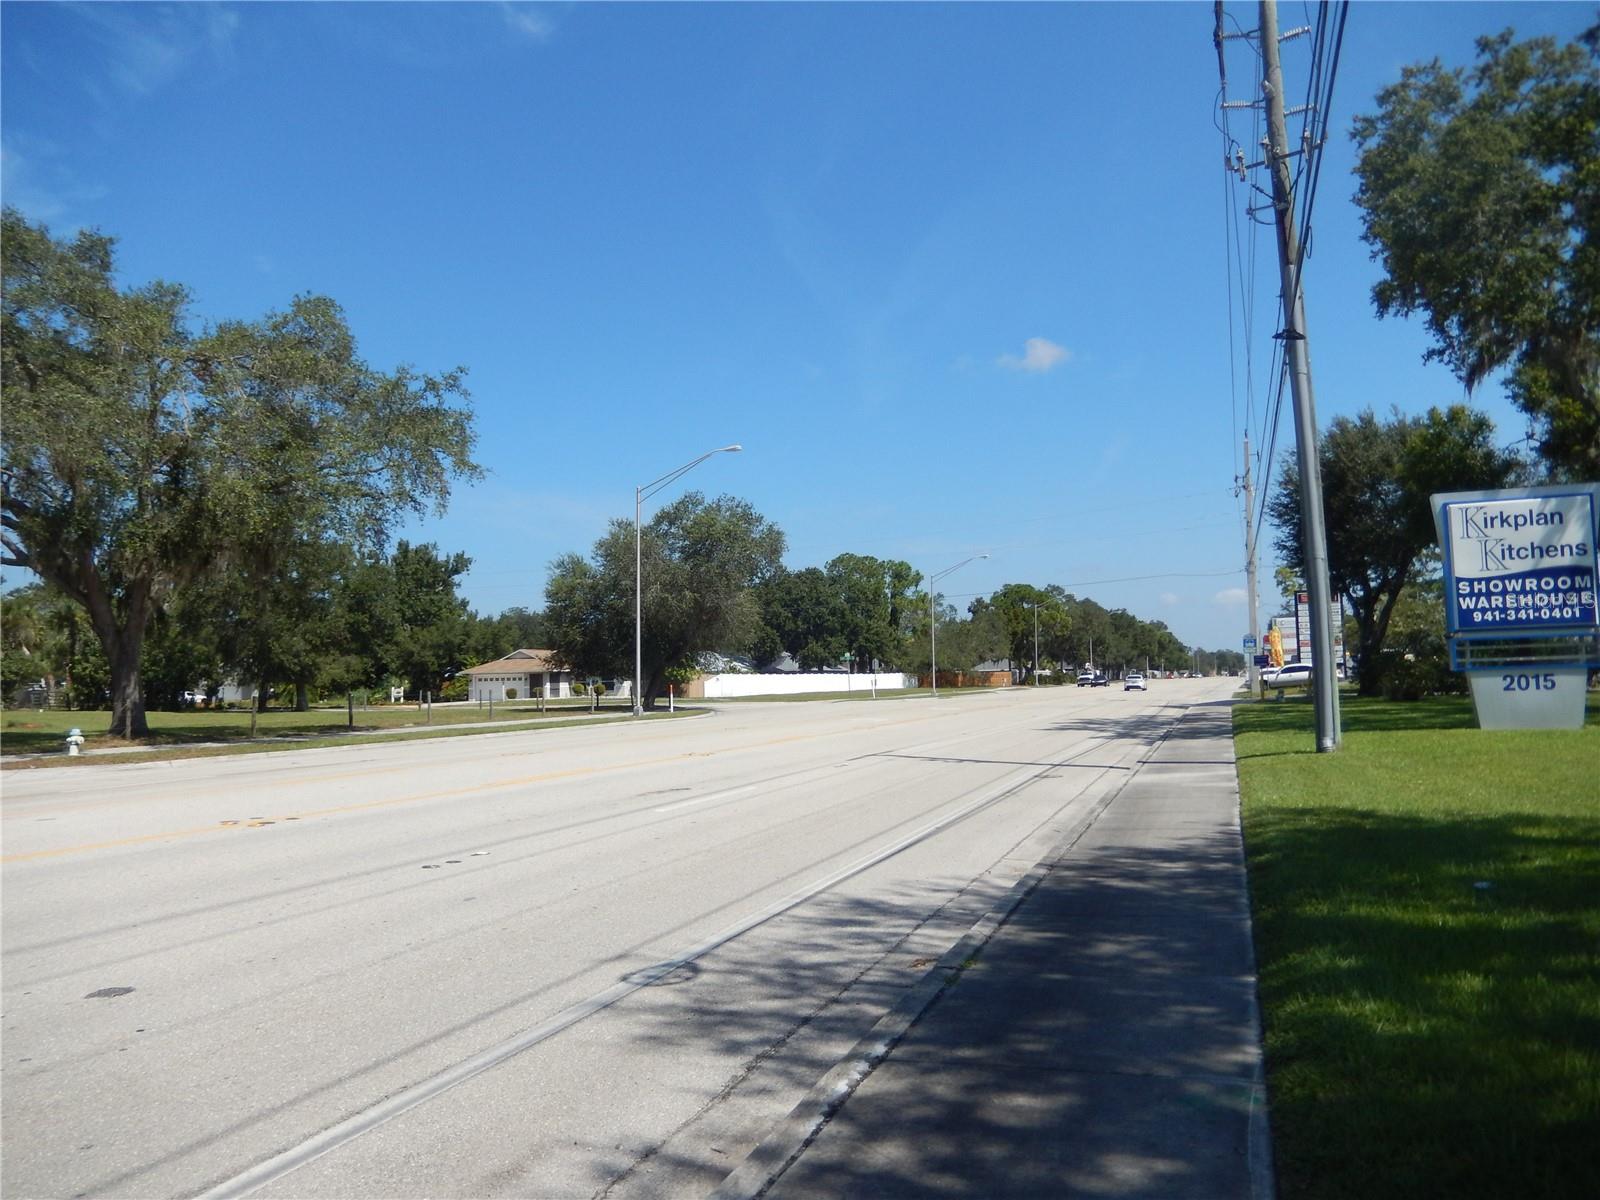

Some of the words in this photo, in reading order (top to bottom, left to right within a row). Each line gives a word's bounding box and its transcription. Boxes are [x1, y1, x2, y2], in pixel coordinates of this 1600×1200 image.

[1459, 506, 1563, 539] Kirkplan
[1478, 538, 1588, 571] Kitchens
[1458, 575, 1591, 594] SHOWROOM
[1459, 590, 1592, 609] WAREHOUSE
[1473, 607, 1580, 622] 941-341-0401
[1503, 674, 1556, 691] 2015
